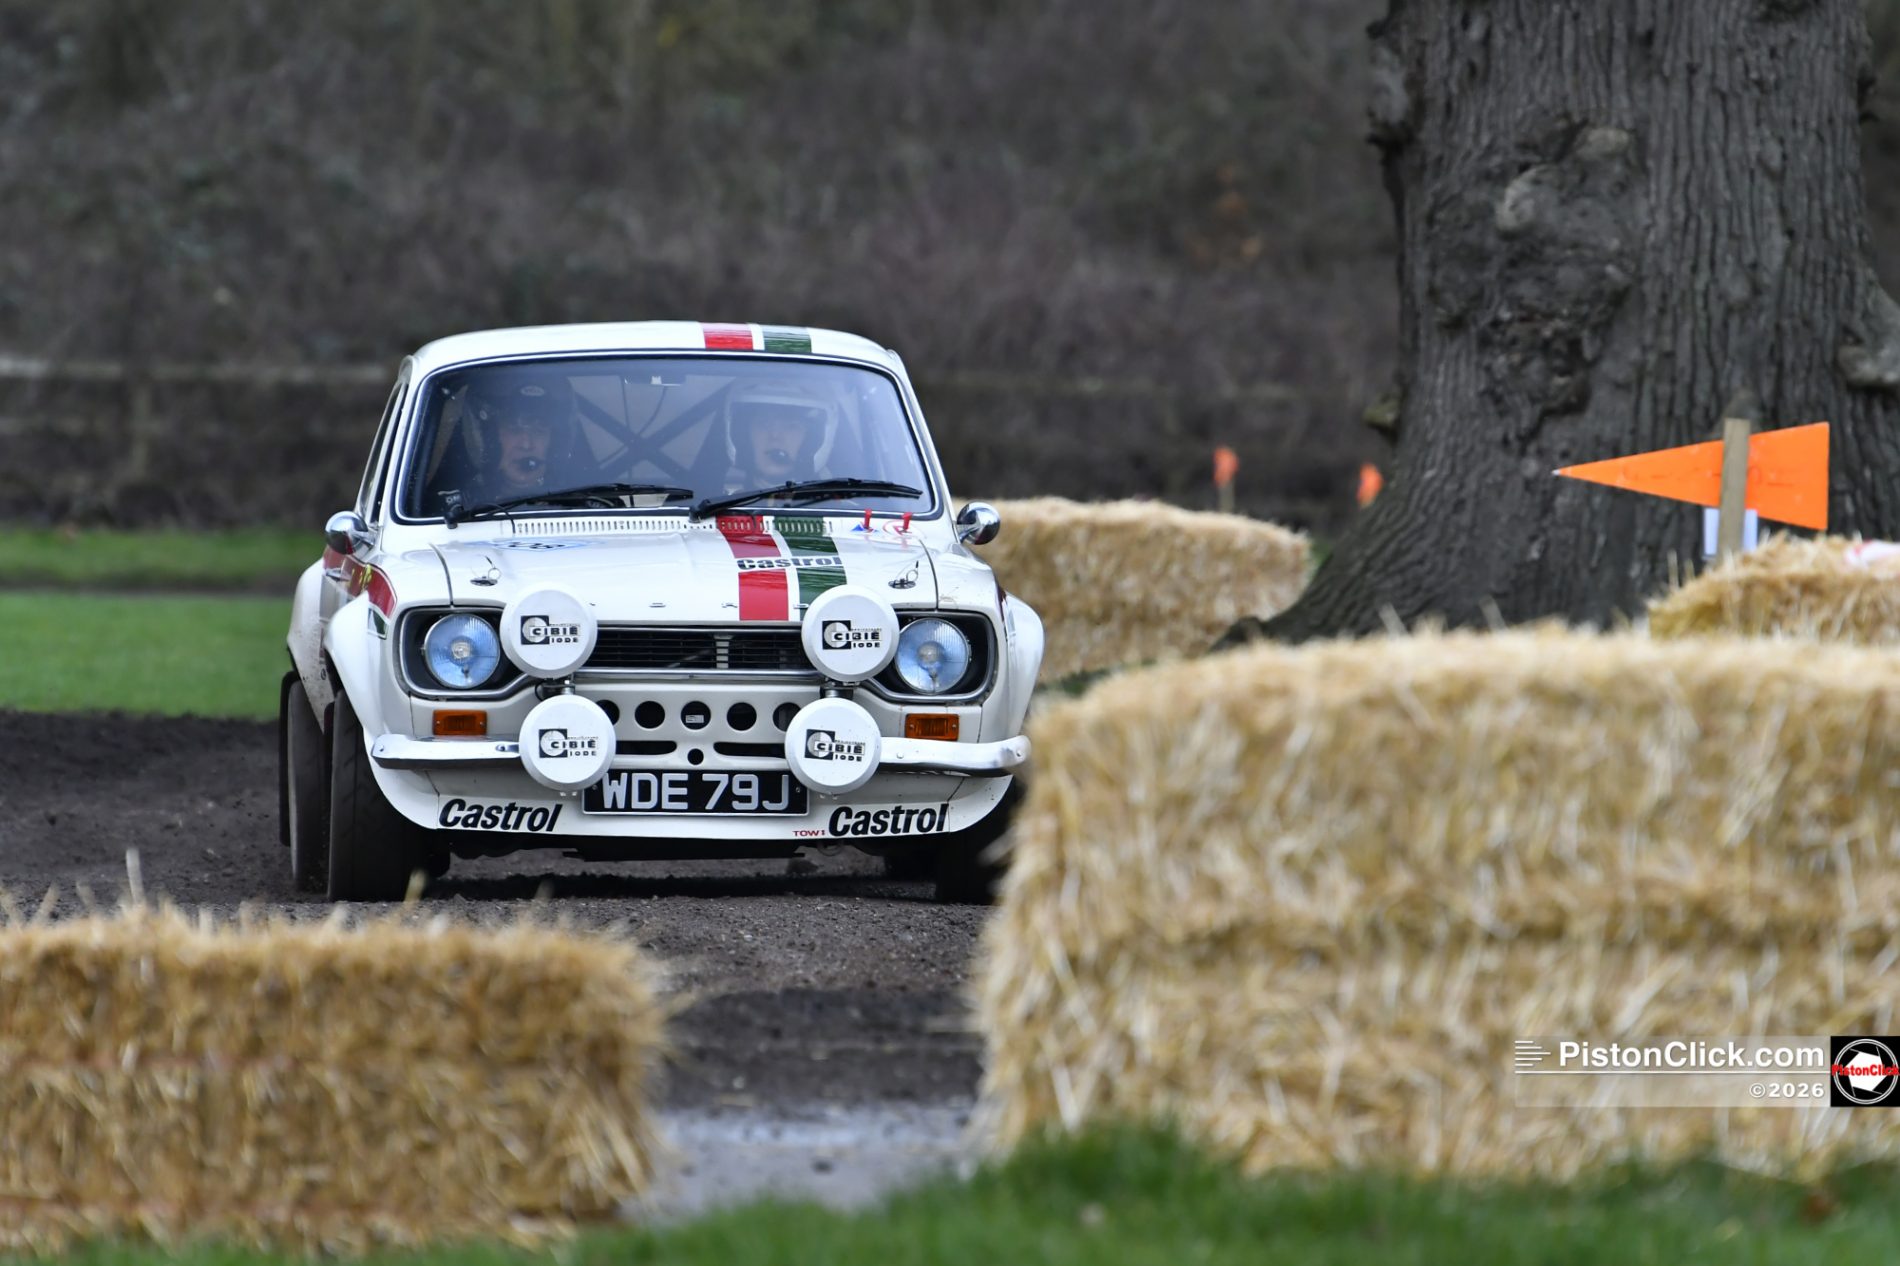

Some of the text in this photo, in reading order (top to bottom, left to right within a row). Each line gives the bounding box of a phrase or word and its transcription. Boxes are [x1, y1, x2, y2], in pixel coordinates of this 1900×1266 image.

[737, 557, 843, 570] Castrol
[835, 754, 862, 762] IODE
[602, 773, 790, 811] WDE 79J
[439, 798, 563, 832] Castrol
[828, 803, 949, 837] Castrol
